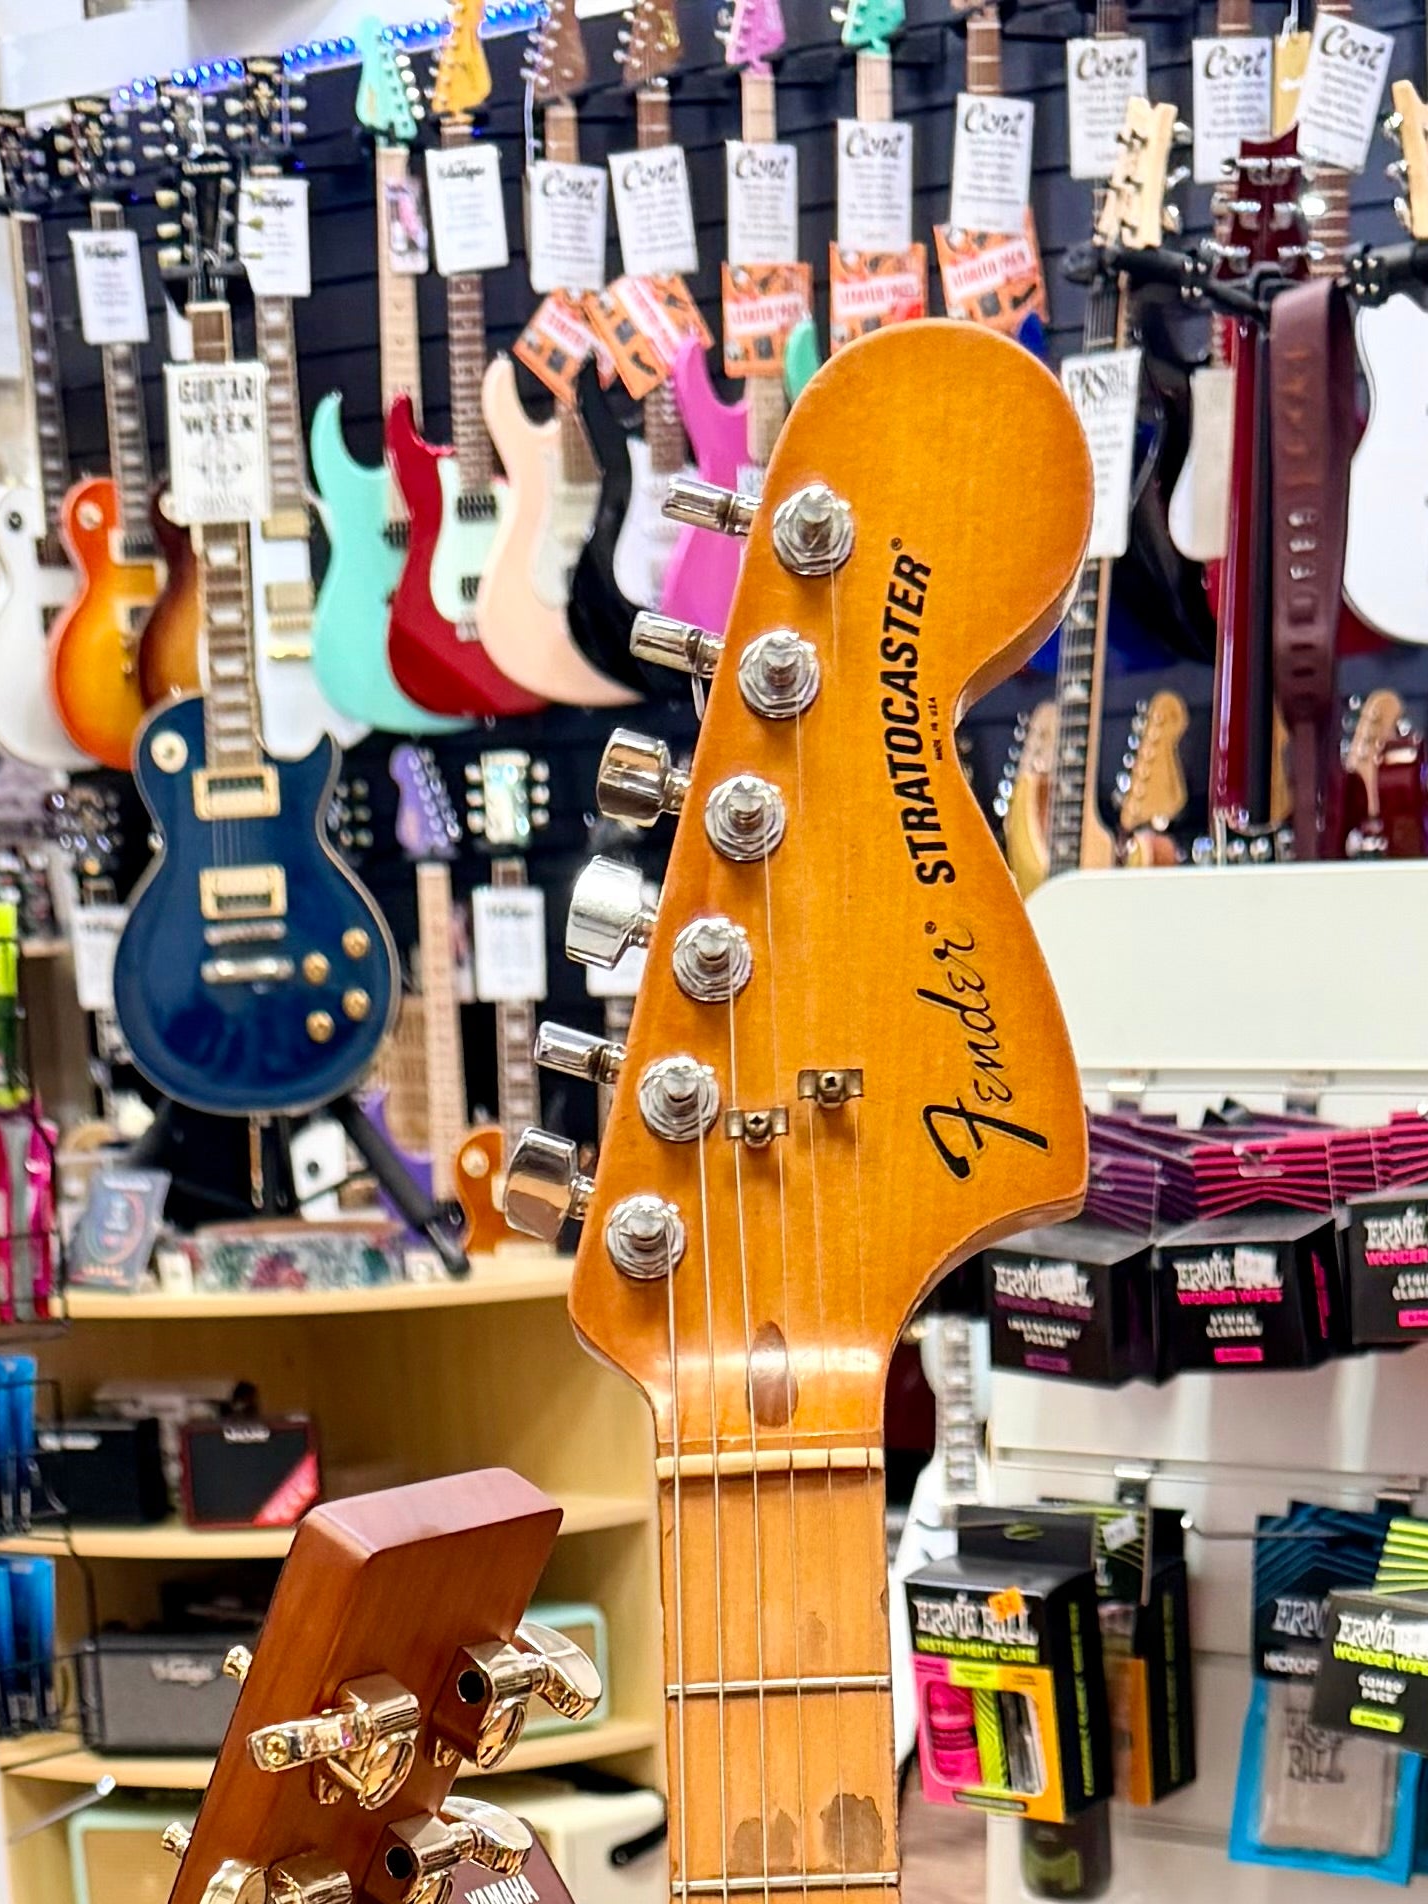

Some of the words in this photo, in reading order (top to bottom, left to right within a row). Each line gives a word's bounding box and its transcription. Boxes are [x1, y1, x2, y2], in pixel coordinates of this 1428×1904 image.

[1077, 47, 1138, 81] Cort
[1203, 45, 1267, 79] Cort
[1319, 24, 1385, 71] Cort
[964, 102, 1025, 138] Cort
[182, 414, 254, 437] WEEK
[879, 554, 956, 885] STRATOCASTER
[916, 924, 1052, 1180] Fender
[1363, 1205, 1428, 1251] ERNIE
[1173, 1250, 1233, 1291] ERNIE
[1364, 1249, 1428, 1266] WONDER
[1176, 1289, 1238, 1305] WONDER
[1239, 1287, 1284, 1303] WIPES
[912, 1590, 980, 1641] ERNIE
[1273, 1598, 1330, 1639] ERN
[1335, 1609, 1397, 1652] ERNIE
[916, 1636, 996, 1661] INSTRUMENT
[999, 1645, 1039, 1664] CARE
[1333, 1642, 1395, 1670] WONDER
